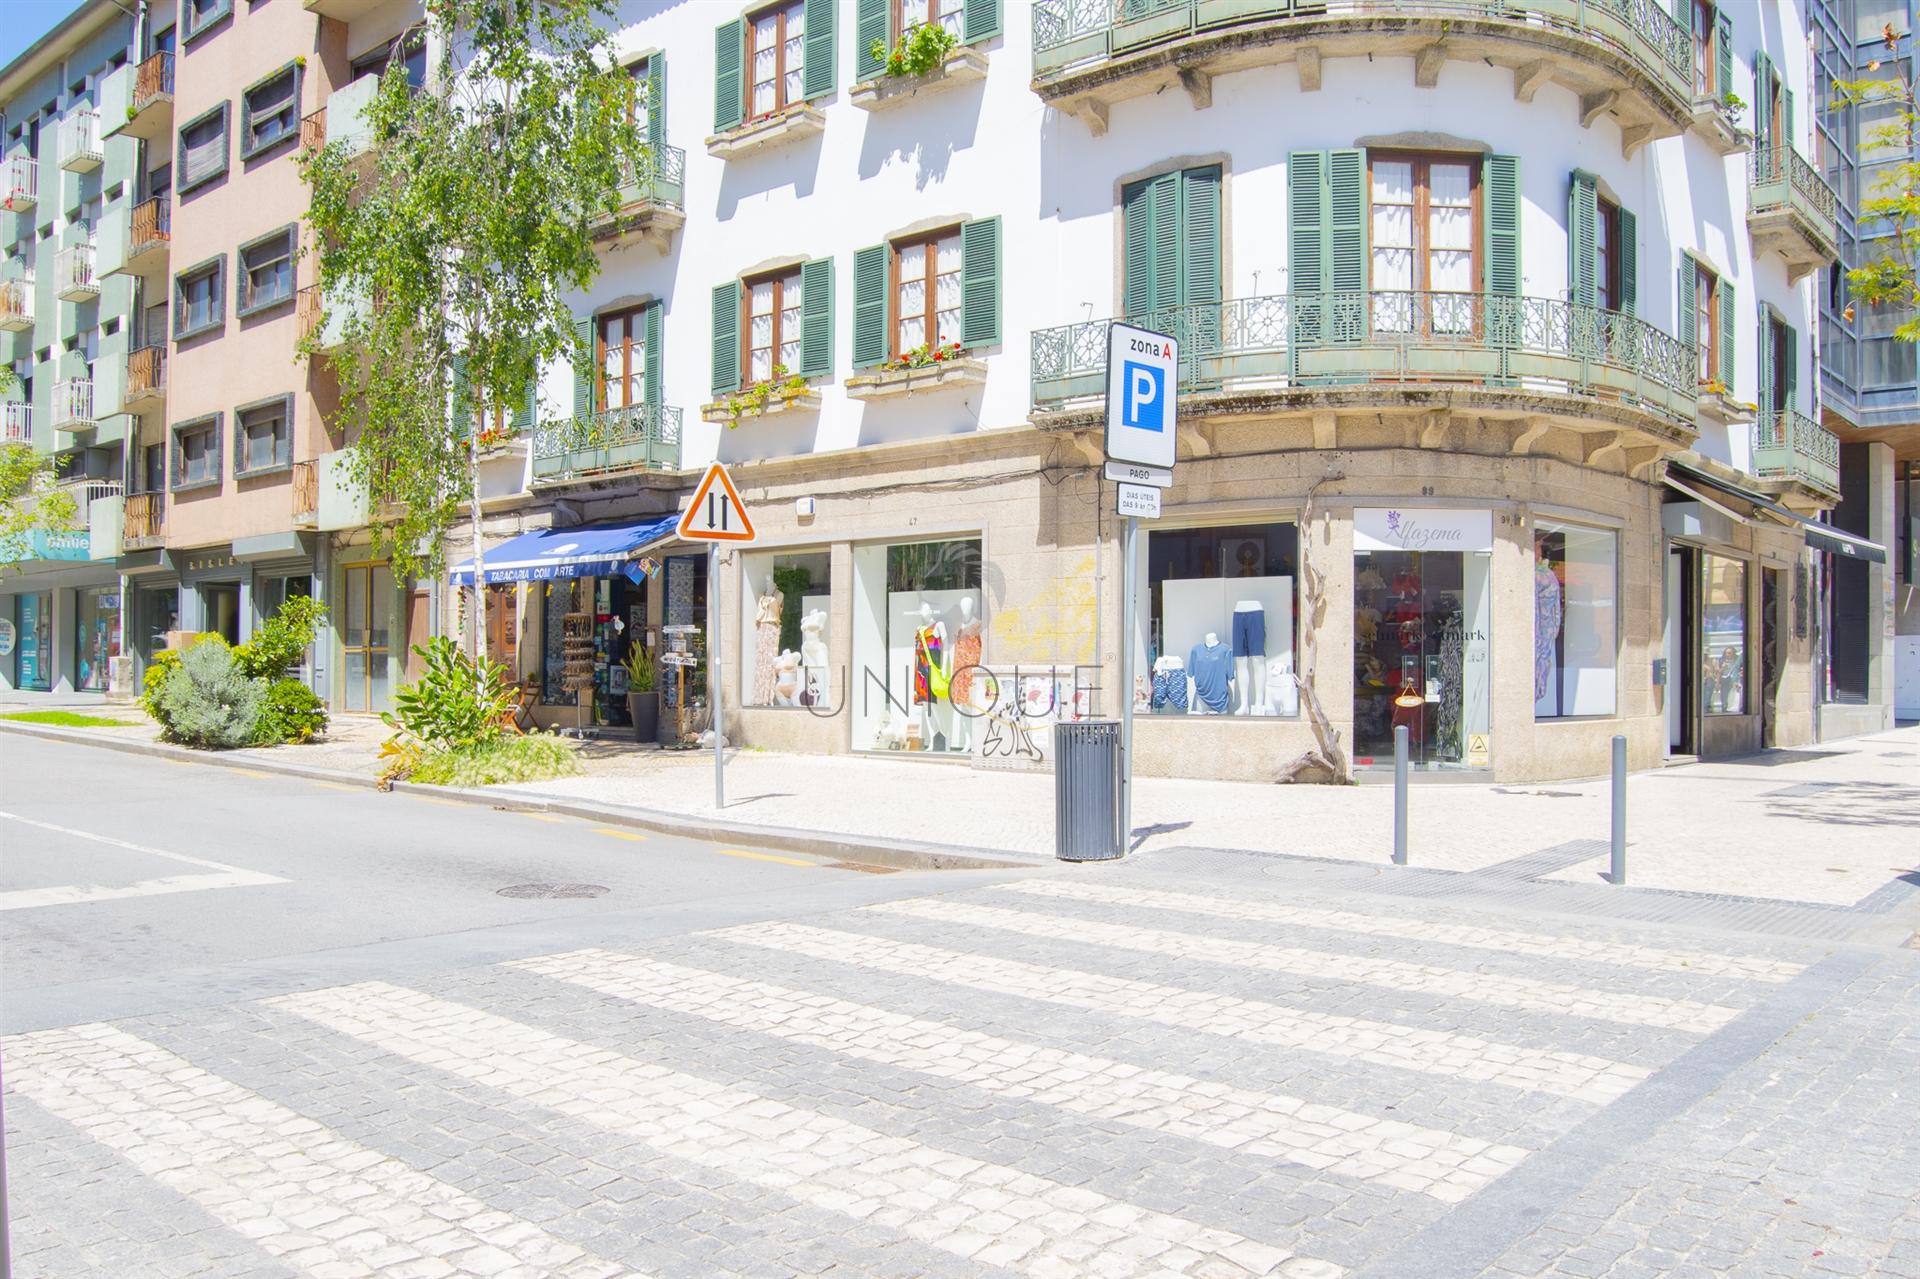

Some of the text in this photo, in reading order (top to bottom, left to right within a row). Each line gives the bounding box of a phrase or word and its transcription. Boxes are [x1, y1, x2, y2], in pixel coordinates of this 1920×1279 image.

[1131, 367, 1157, 423] P
[1129, 469, 1150, 480] PAGO
[491, 564, 575, 582] TABACARIA COM ARTE
